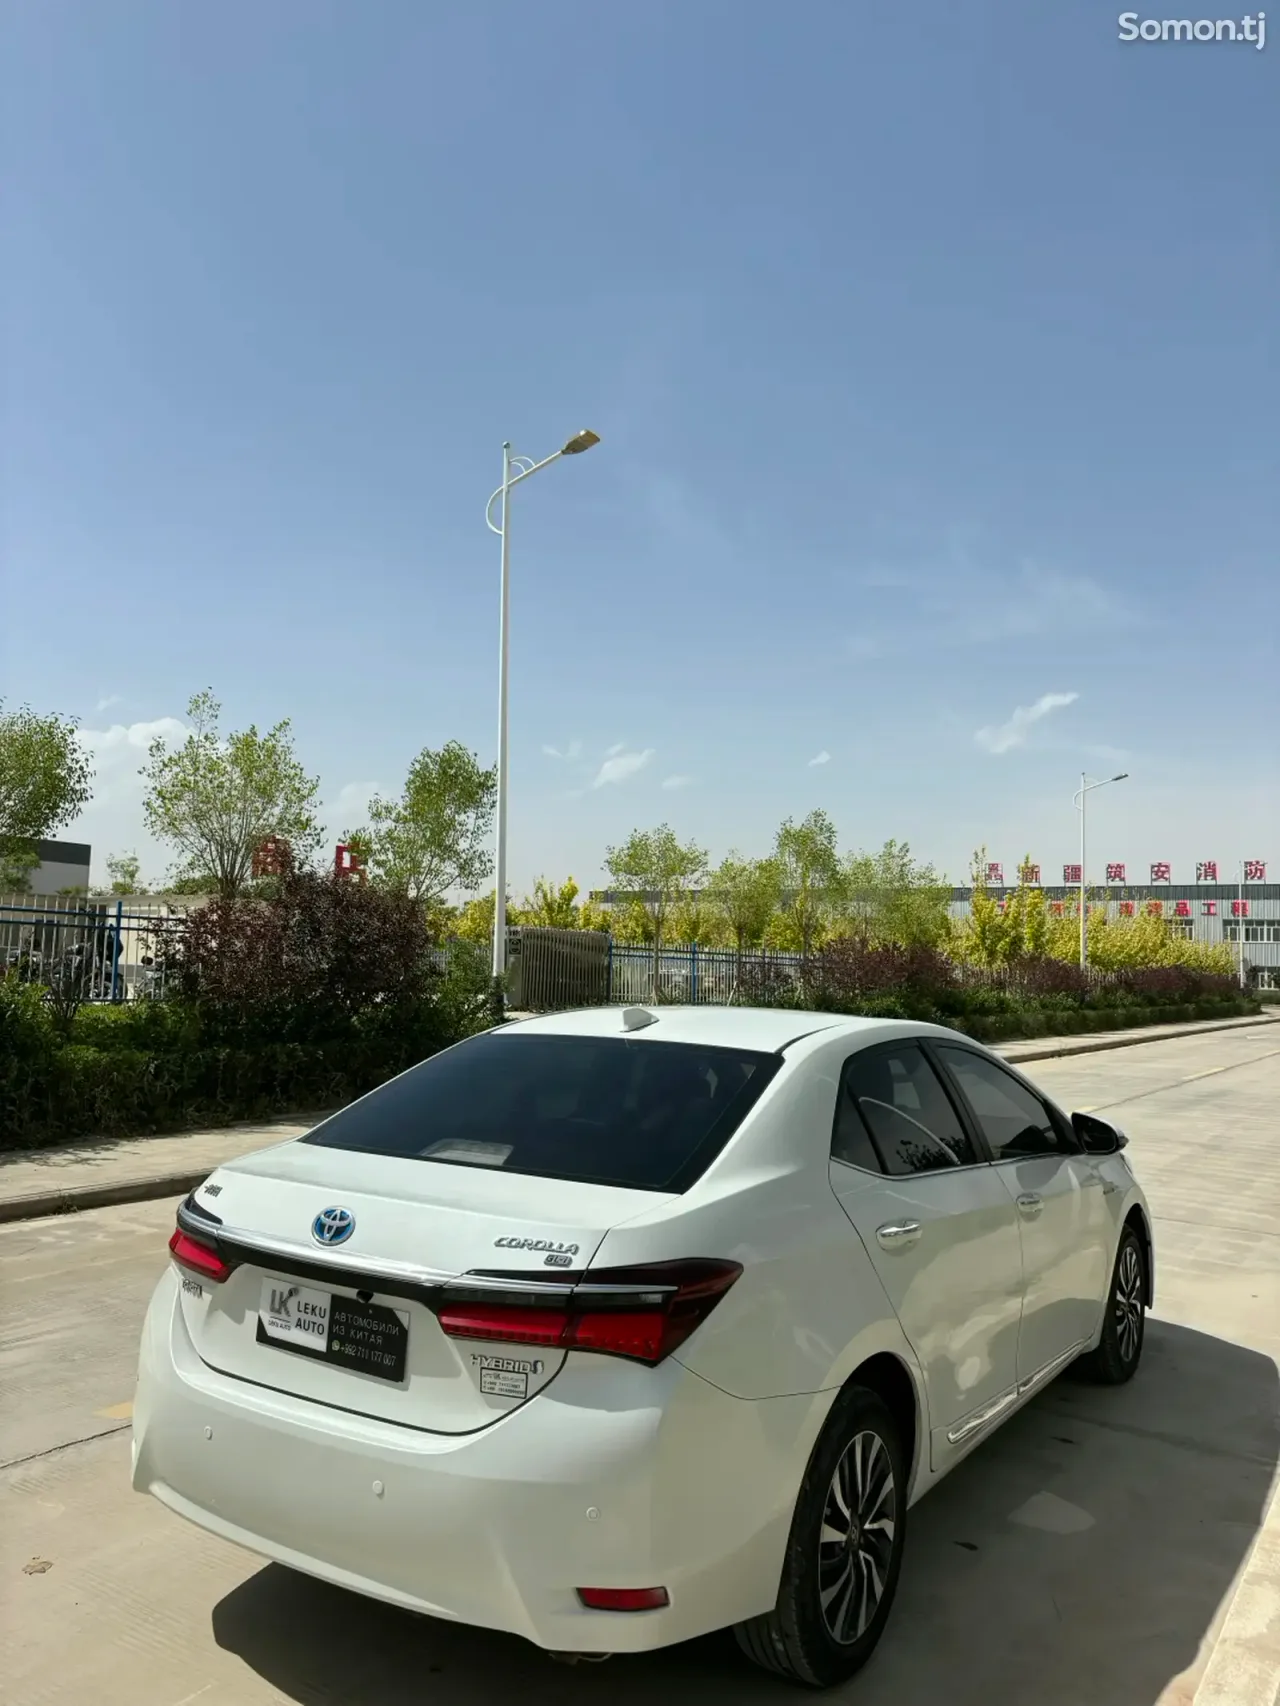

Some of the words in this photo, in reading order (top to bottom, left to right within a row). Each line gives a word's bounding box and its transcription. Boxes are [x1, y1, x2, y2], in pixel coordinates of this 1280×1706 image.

[494, 1237, 580, 1255] COROLLA
[297, 1301, 327, 1319] LEKU
[295, 1318, 325, 1335] AUTO
[334, 1311, 400, 1336] АВТОМОБИЛИ
[332, 1324, 345, 1336] ИЗ
[350, 1329, 383, 1346] КИТАЯ
[470, 1354, 531, 1373] HYBRID
